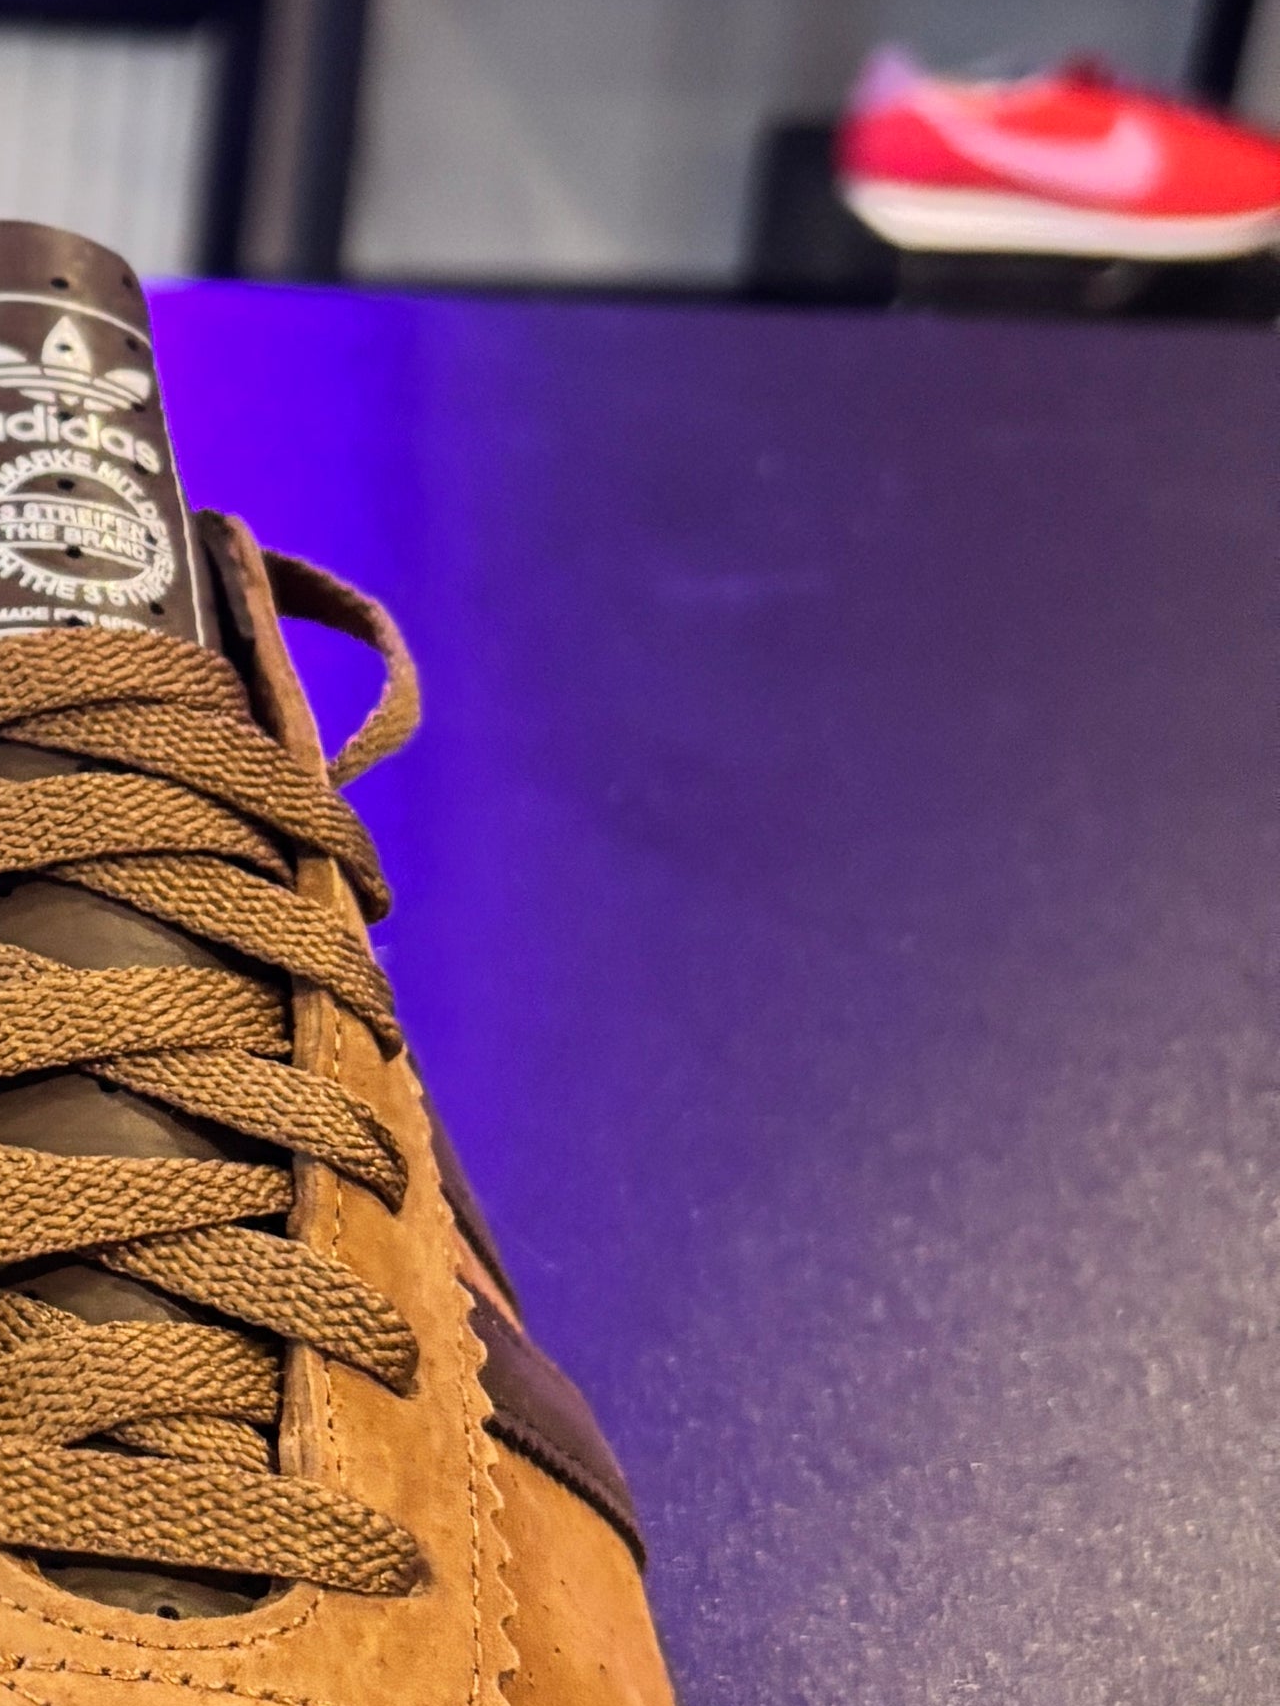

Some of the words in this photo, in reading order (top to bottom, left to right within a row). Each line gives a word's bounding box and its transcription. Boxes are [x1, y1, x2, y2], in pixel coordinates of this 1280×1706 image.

[96, 460, 146, 499] MIT
[0, 525, 56, 540] THE
[64, 527, 147, 560] BRAND
[19, 565, 76, 602] THE
